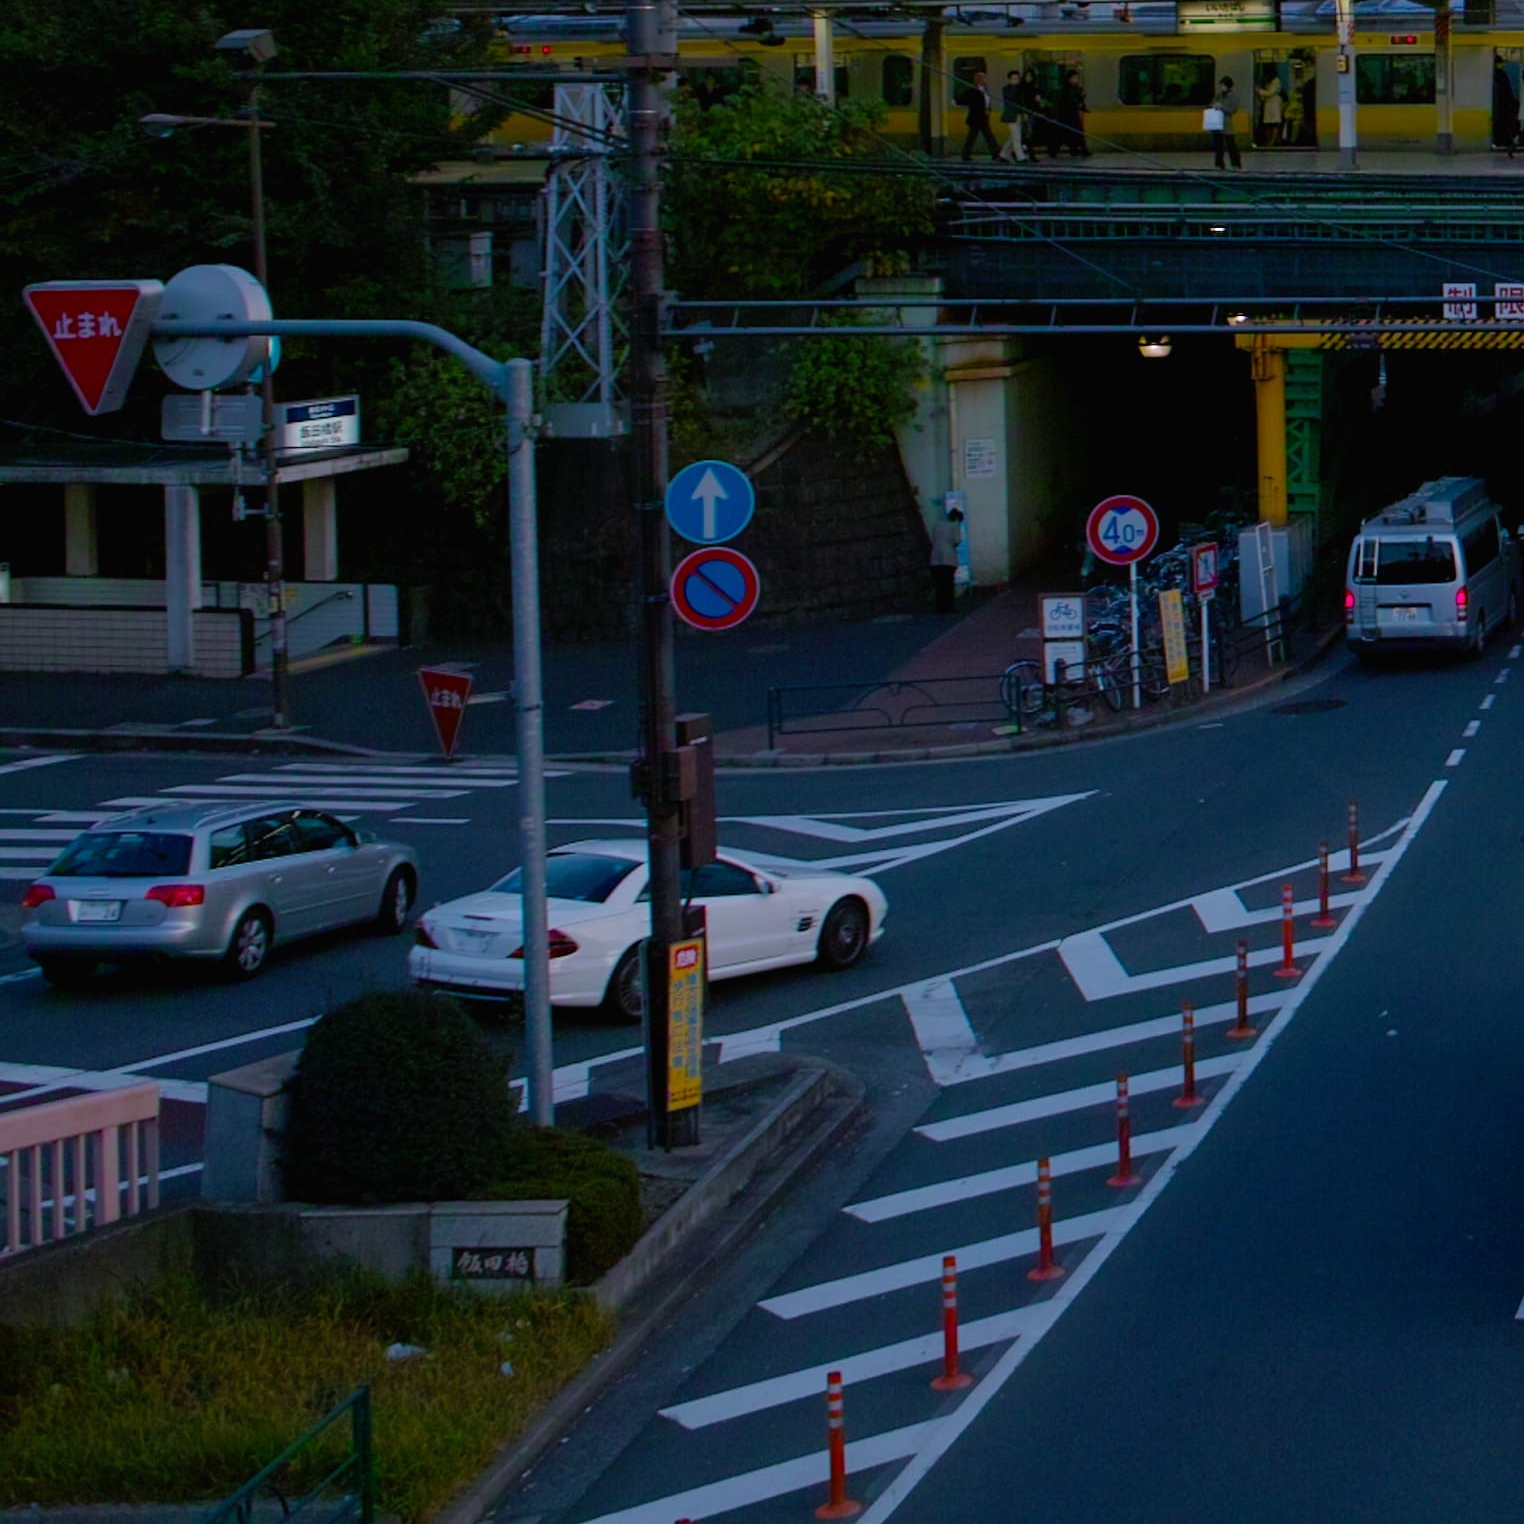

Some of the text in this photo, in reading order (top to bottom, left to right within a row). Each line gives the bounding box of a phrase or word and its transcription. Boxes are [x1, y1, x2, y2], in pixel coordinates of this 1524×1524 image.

[53, 311, 122, 339] 止まれ
[431, 686, 462, 709] 止まれ
